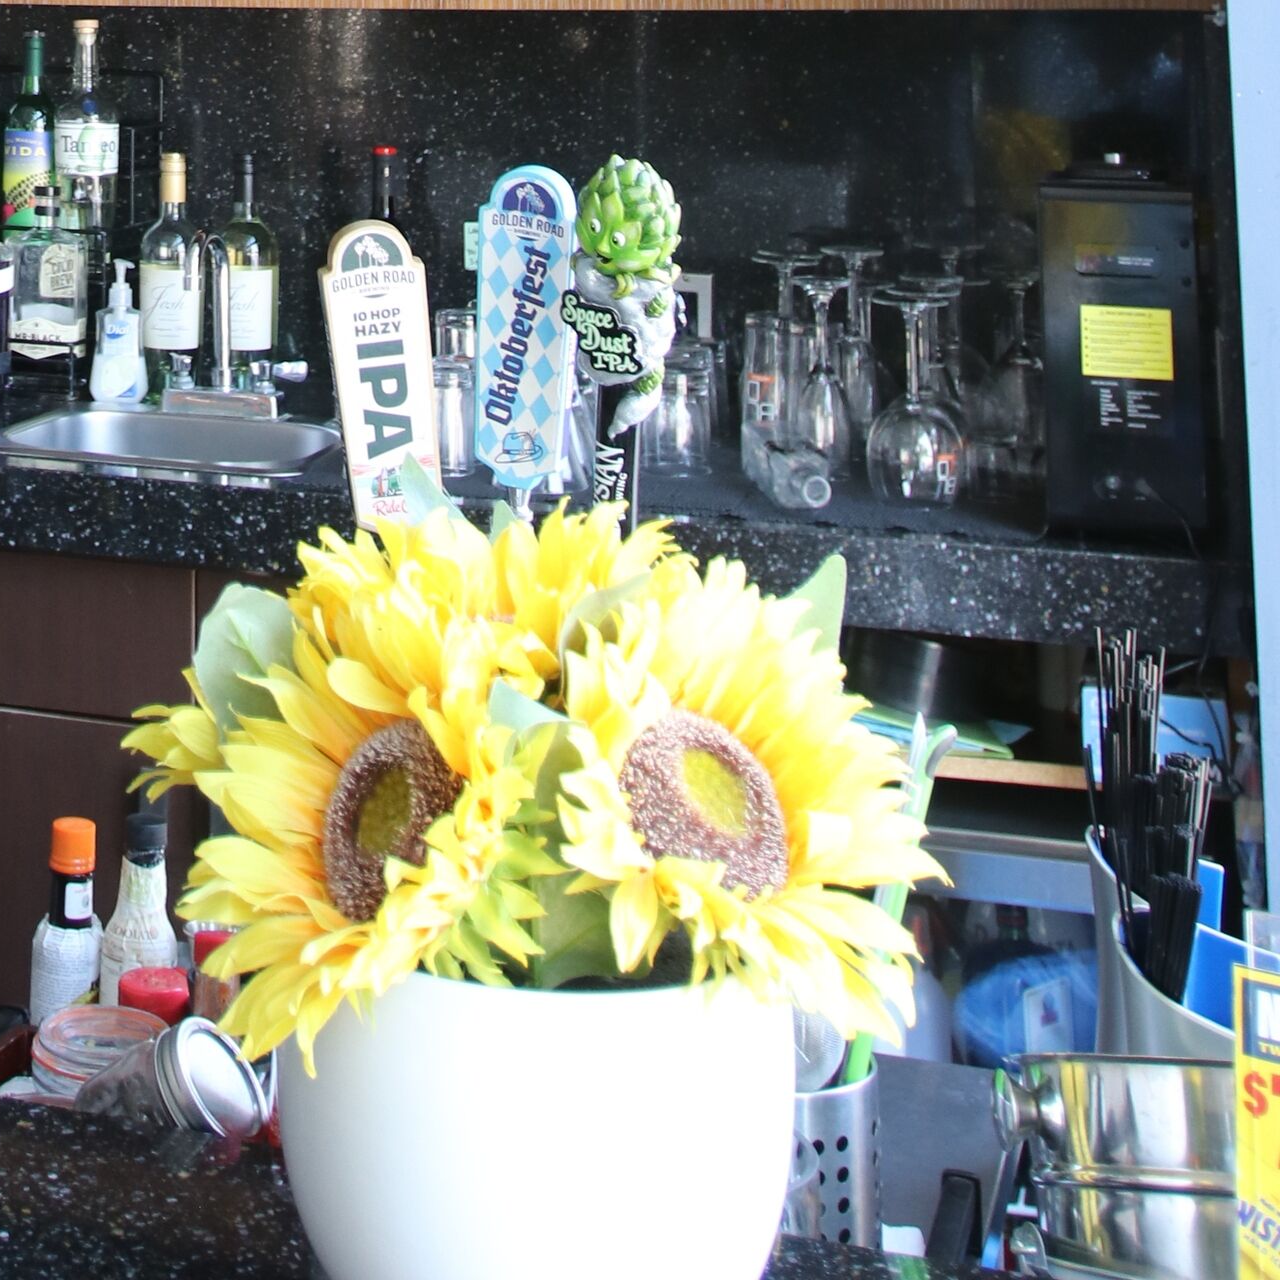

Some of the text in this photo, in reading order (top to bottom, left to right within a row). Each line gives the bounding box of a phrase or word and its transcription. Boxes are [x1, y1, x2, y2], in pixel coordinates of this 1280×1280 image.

[3, 145, 47, 158] VIDA
[60, 134, 116, 154] Taneo
[491, 213, 565, 239] GOLDEN ROAD
[331, 269, 416, 293] GOLDEN ROAD
[353, 307, 401, 323] 10 HOP
[562, 293, 614, 332] Space
[354, 320, 402, 337] HAZY
[484, 243, 552, 427] Oktoberfest
[580, 322, 633, 354] Dust
[592, 350, 639, 374] IPA
[356, 338, 414, 460] IPA
[593, 441, 625, 506] SIAN
